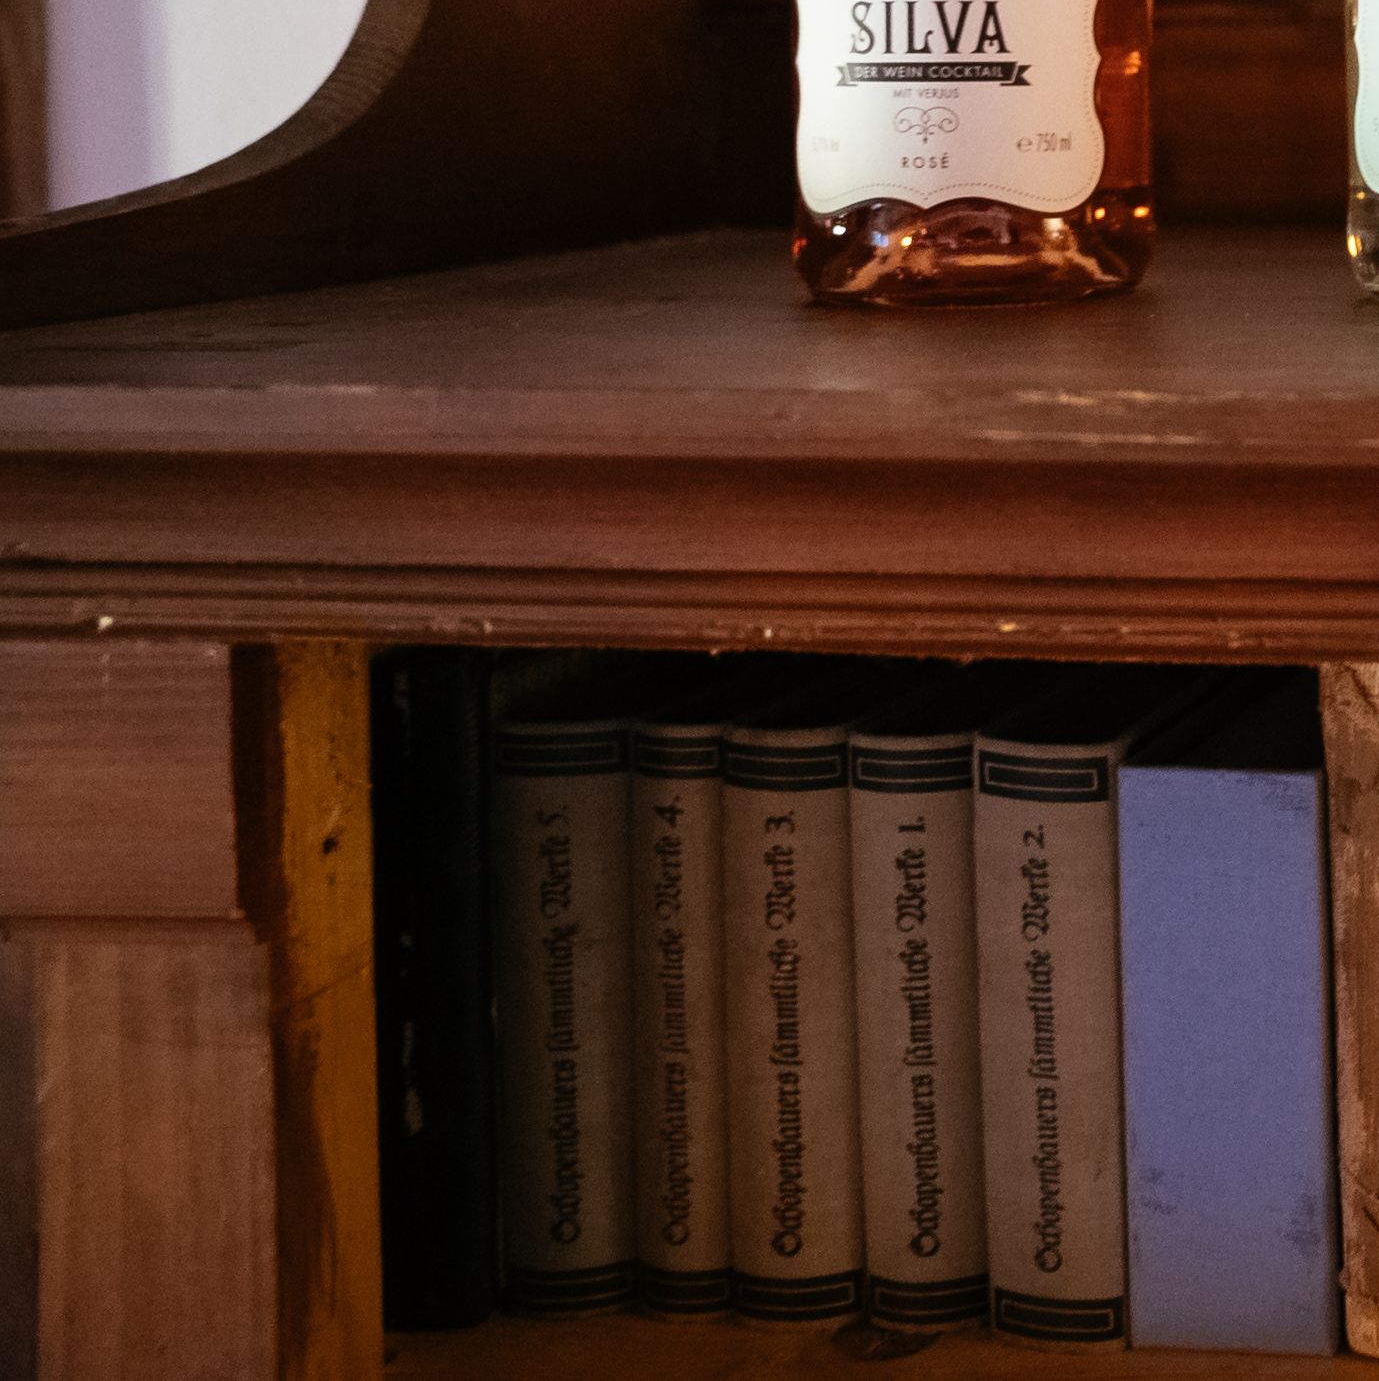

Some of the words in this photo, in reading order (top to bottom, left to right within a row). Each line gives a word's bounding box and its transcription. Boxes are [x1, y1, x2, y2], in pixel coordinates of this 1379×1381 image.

[849, 0, 1013, 55] SILVA
[853, 64, 880, 79] DER
[883, 64, 924, 79] WEIN
[928, 64, 1005, 79] COCKTAIL
[918, 87, 961, 99] VERJUS
[901, 152, 951, 169] ROSÉ
